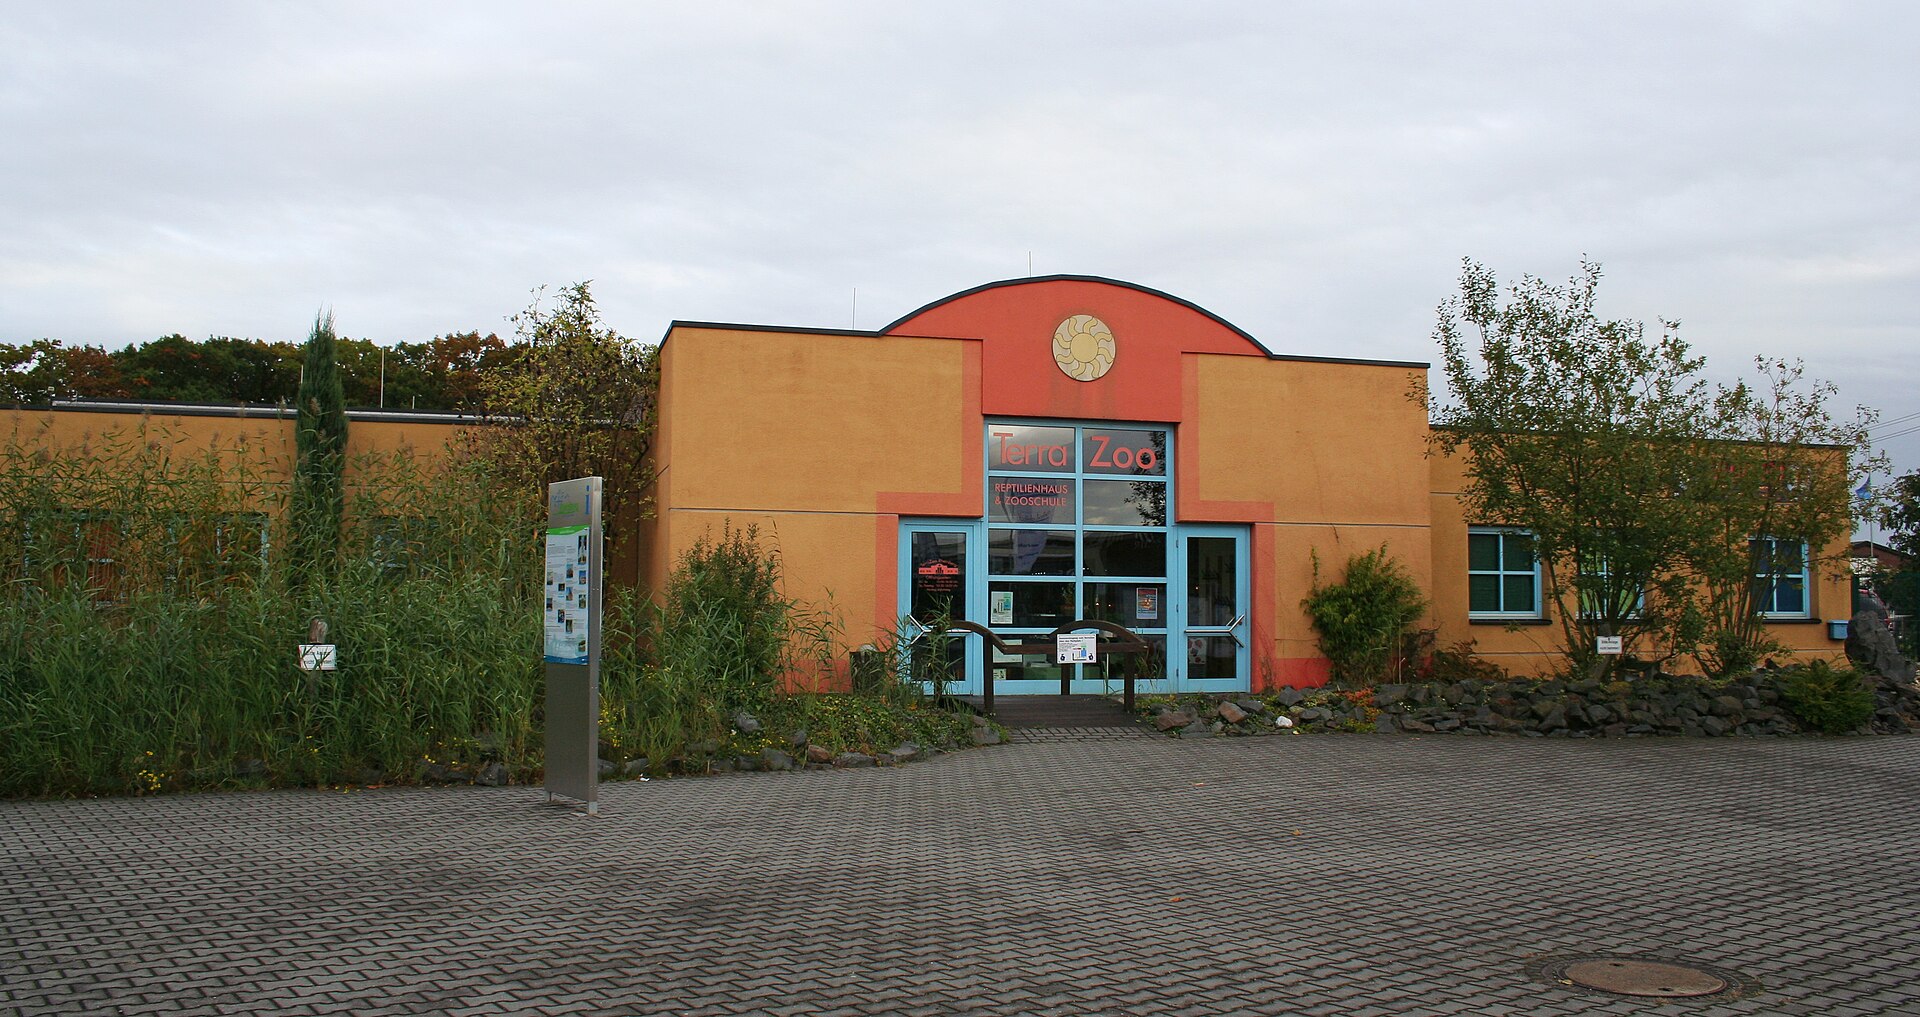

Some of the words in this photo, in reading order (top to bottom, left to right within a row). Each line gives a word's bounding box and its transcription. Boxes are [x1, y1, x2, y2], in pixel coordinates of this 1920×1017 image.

[993, 432, 1068, 467] Terra
[1090, 435, 1156, 469] Zoo
[994, 483, 1068, 494] REPTILIENHAUS
[994, 496, 1001, 505] &
[1005, 496, 1066, 506] ZOOSCHULE
